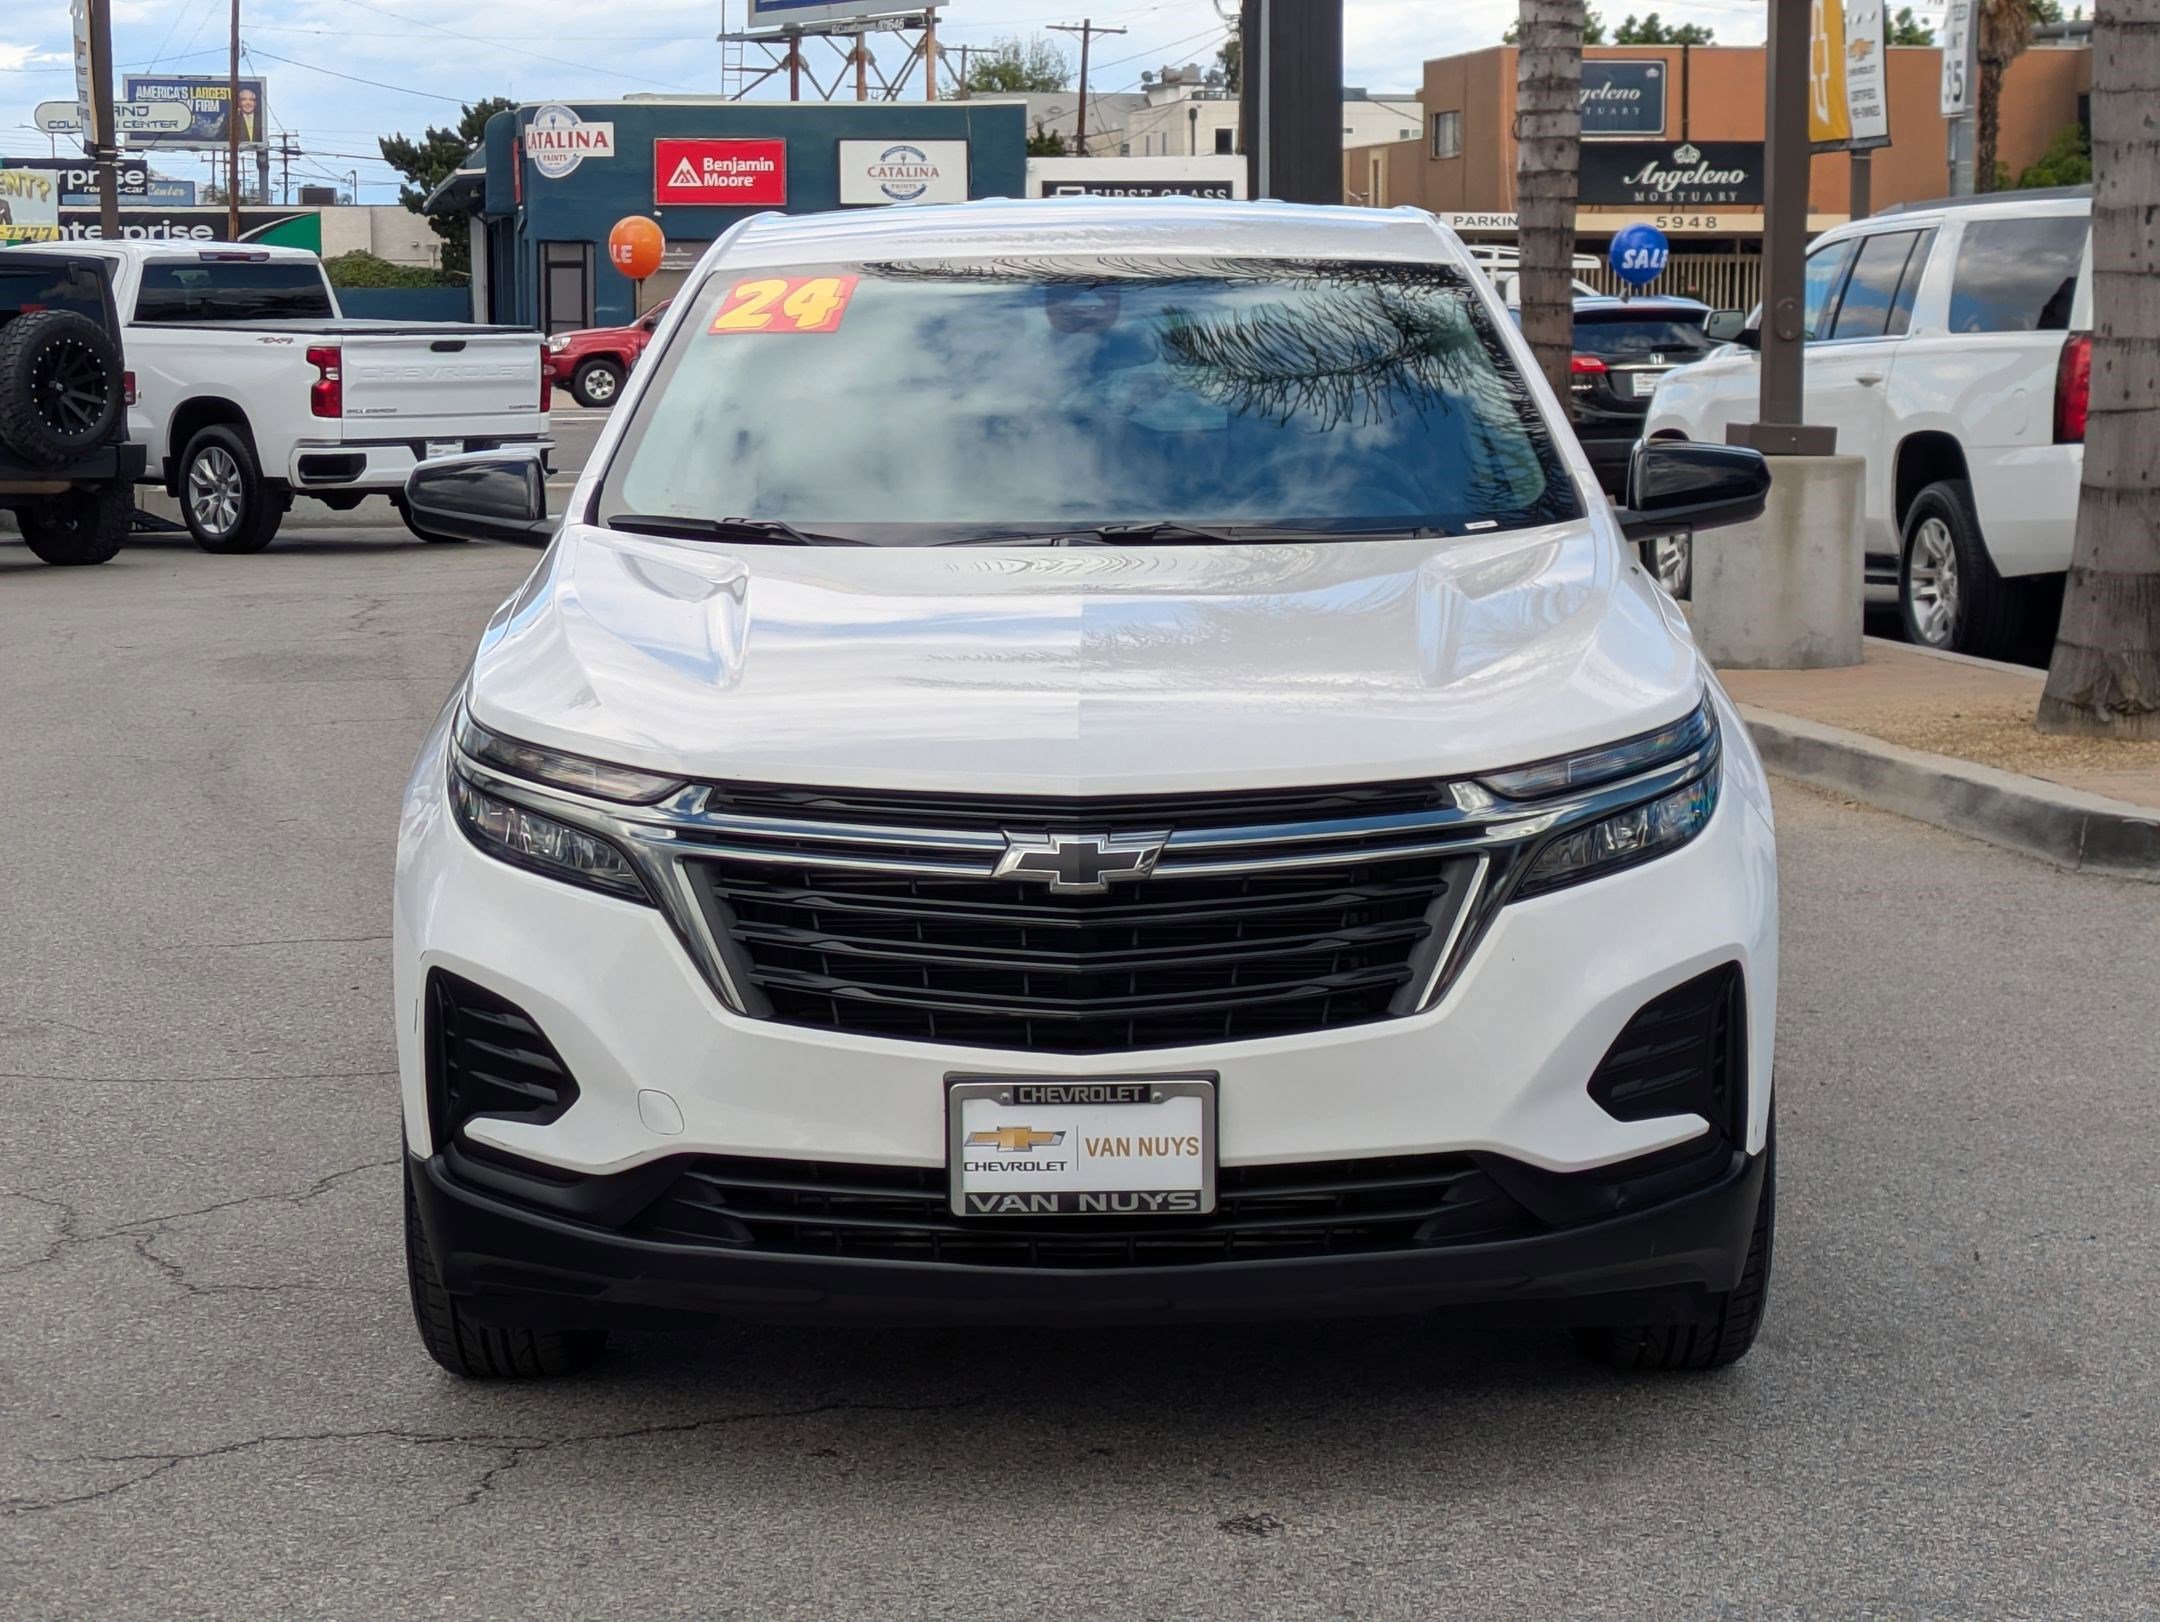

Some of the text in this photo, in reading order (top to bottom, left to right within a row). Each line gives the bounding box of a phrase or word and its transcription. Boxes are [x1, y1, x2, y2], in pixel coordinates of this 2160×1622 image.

[136, 86, 231, 100] AMERICA'S LARGEST
[195, 100, 219, 112] FIRM
[123, 120, 178, 128] CENTER
[526, 131, 609, 151] CATALINA
[543, 154, 568, 162] PAINTS
[703, 157, 775, 174] Benjamin
[867, 167, 940, 178] CATALINA
[1622, 160, 1747, 193] Angeleno
[1634, 192, 1738, 202] MORTUARY
[1453, 216, 1519, 226] PARKIN
[1656, 216, 1717, 229] 5948
[714, 277, 846, 330] 24
[359, 364, 533, 381] CHEVROLET
[1019, 1086, 1144, 1104] CHEVROLET
[1085, 1136, 1200, 1157] VAN NUYS
[963, 1160, 1068, 1172] CHEVROLET
[968, 1191, 1197, 1213] VAN NUYS
